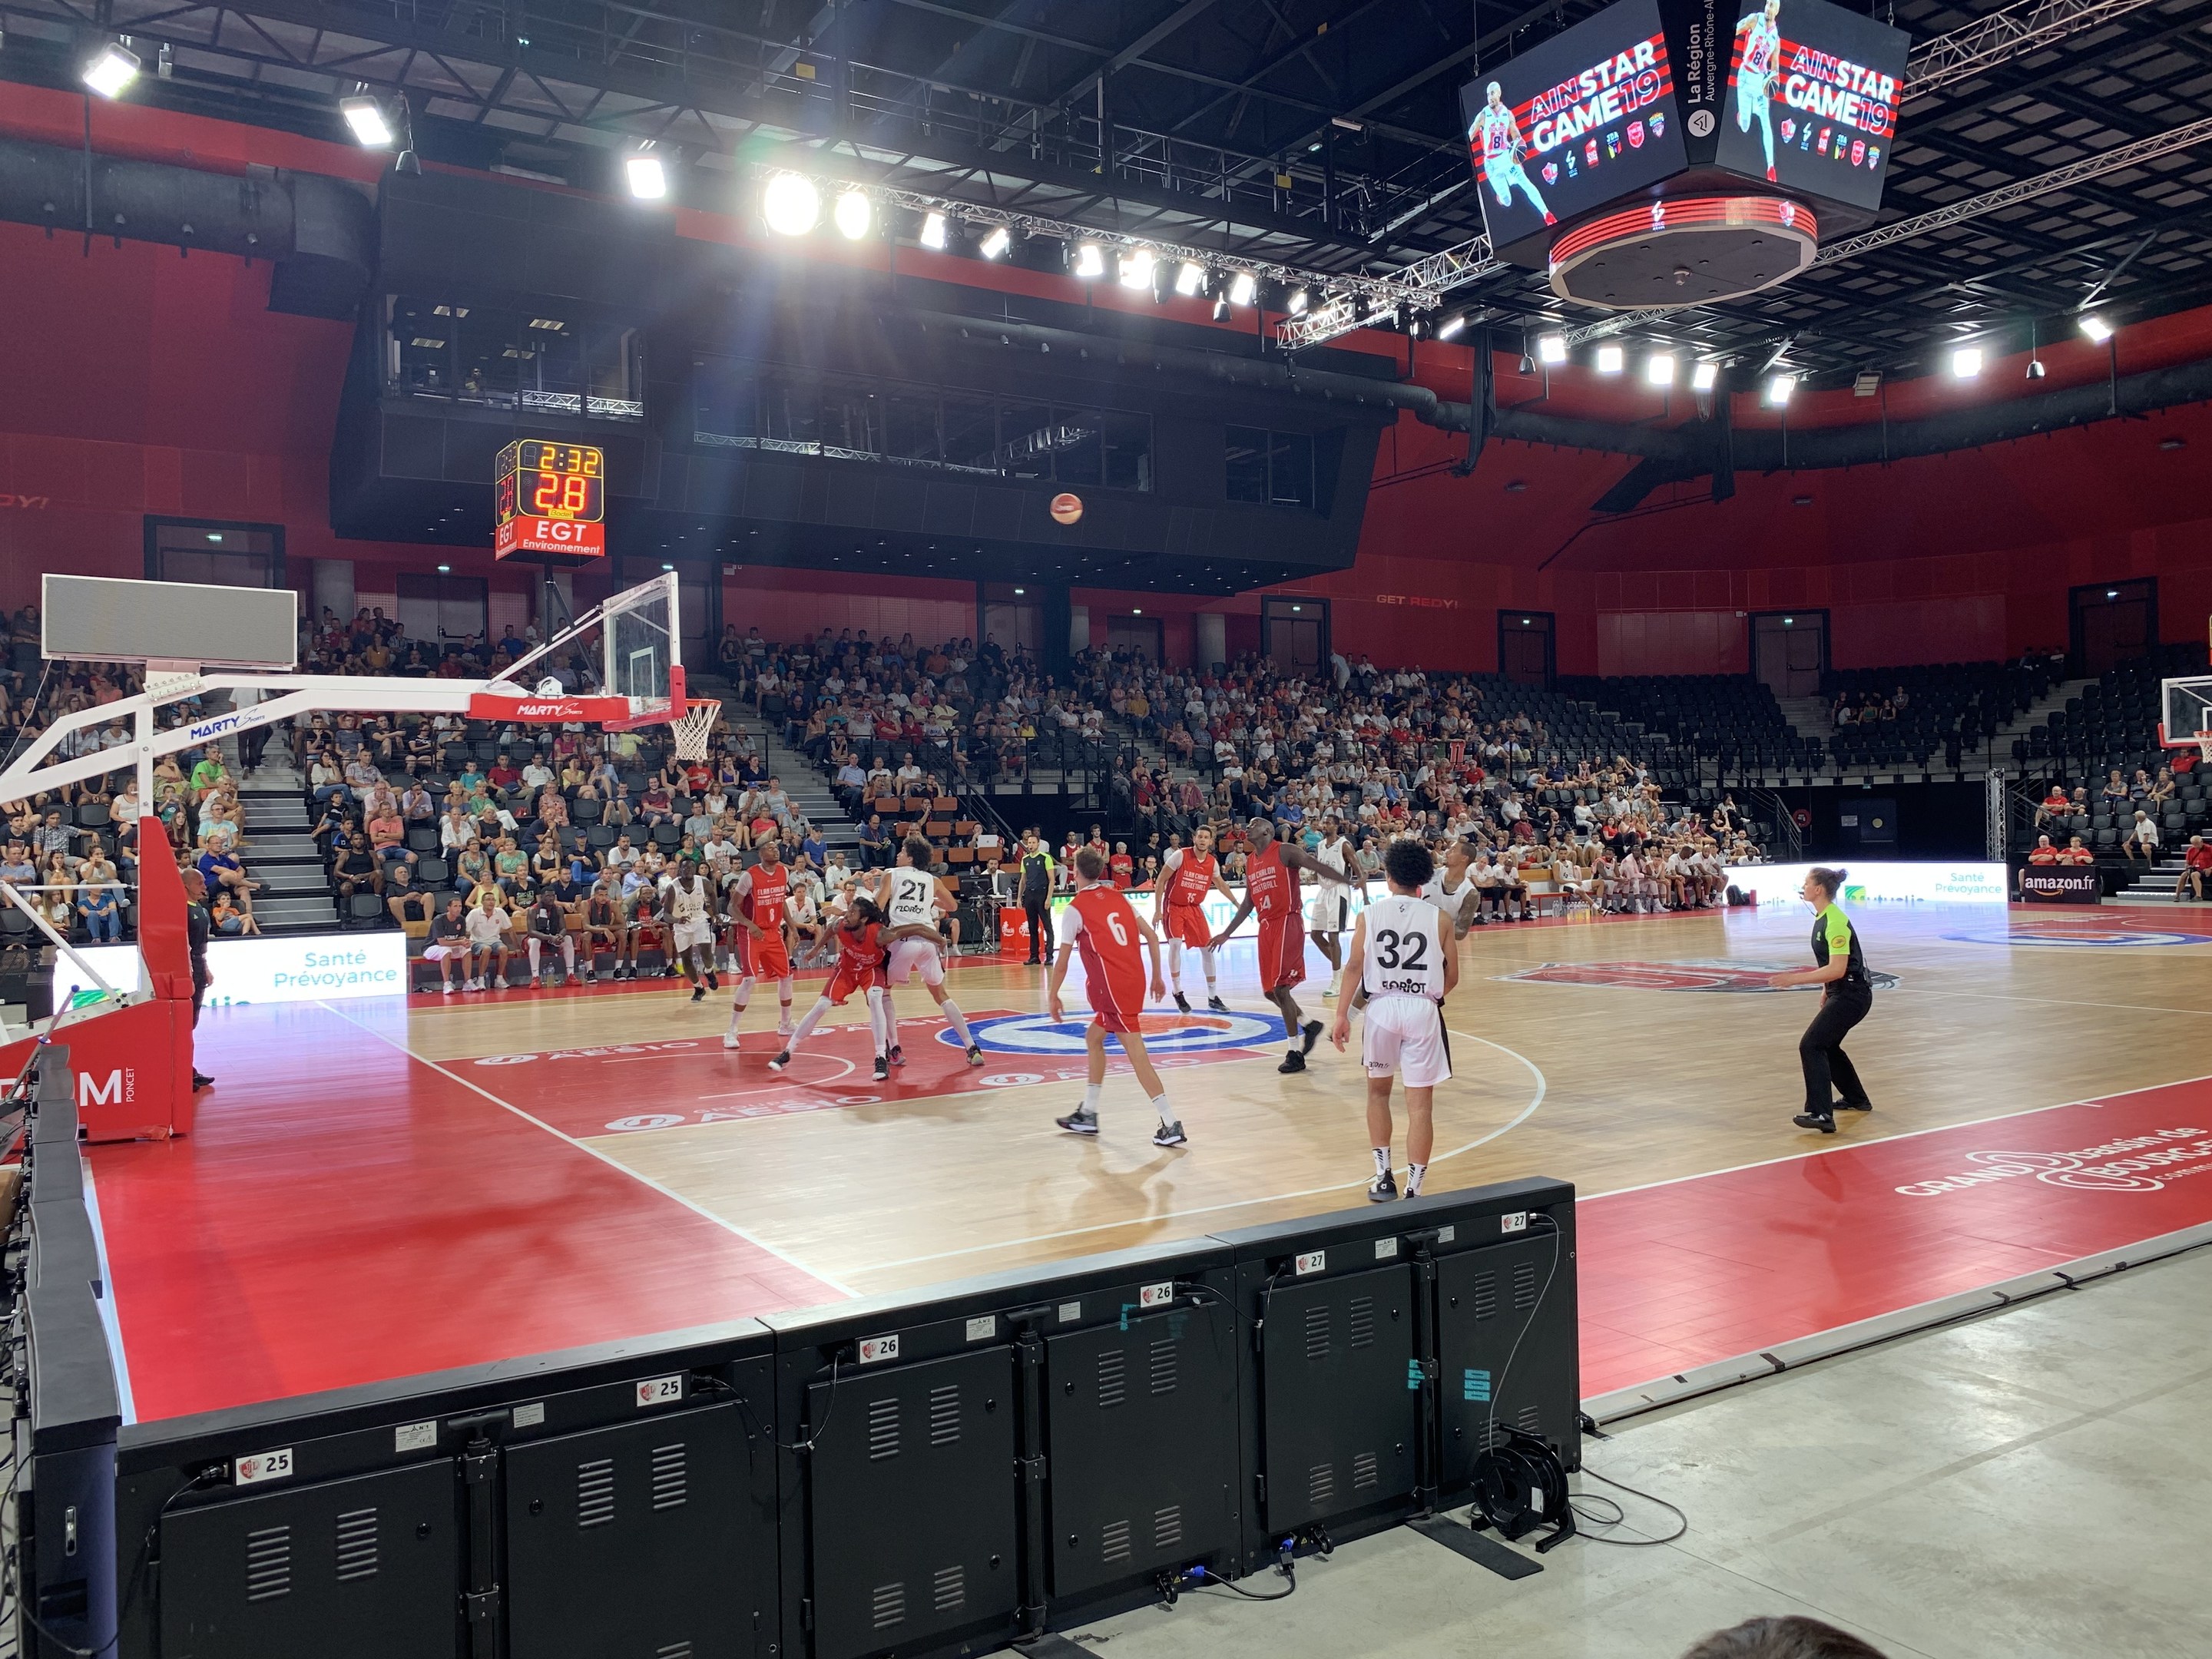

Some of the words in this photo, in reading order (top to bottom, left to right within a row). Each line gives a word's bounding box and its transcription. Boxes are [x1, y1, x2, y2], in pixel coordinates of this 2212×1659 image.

[1687, 24, 1704, 81] Région
[1753, 51, 1763, 65] 8
[1688, 84, 1701, 104] La
[1493, 135, 1501, 149] 8
[540, 446, 598, 475] 2:32
[535, 473, 586, 512] 2.8
[499, 522, 514, 546] EGT
[536, 521, 587, 542] EGT
[522, 538, 601, 554] Environnement
[1376, 594, 1406, 605] GET
[1409, 597, 1459, 609] REDY!
[516, 704, 563, 716] MARTY
[190, 716, 240, 740] MARTY
[1257, 866, 1276, 879] CHALON
[1950, 873, 1985, 882] Santé
[899, 879, 926, 902] 21
[1181, 880, 1206, 892] BASKETBALL
[1935, 883, 2002, 895] Prévoyance
[2025, 875, 2095, 890] amazon.fr
[1187, 892, 1197, 904] 15
[770, 908, 775, 922] 8
[1106, 912, 1128, 946] 6
[1376, 929, 1428, 971] 32
[304, 949, 367, 968] Santé
[274, 968, 397, 988] Prévoyance
[125, 1067, 134, 1103] PONCET
[693, 1099, 798, 1114] GROUPE
[2065, 1136, 2174, 1160] bassin
[2154, 1128, 2209, 1138] de
[1894, 1164, 2035, 1197] GRAND
[1514, 1215, 1525, 1227] 27
[1311, 1254, 1323, 1267] 27
[1157, 1286, 1171, 1300] 26
[880, 1339, 896, 1354] 26
[661, 1380, 679, 1396] 25
[266, 1454, 289, 1472] 25
